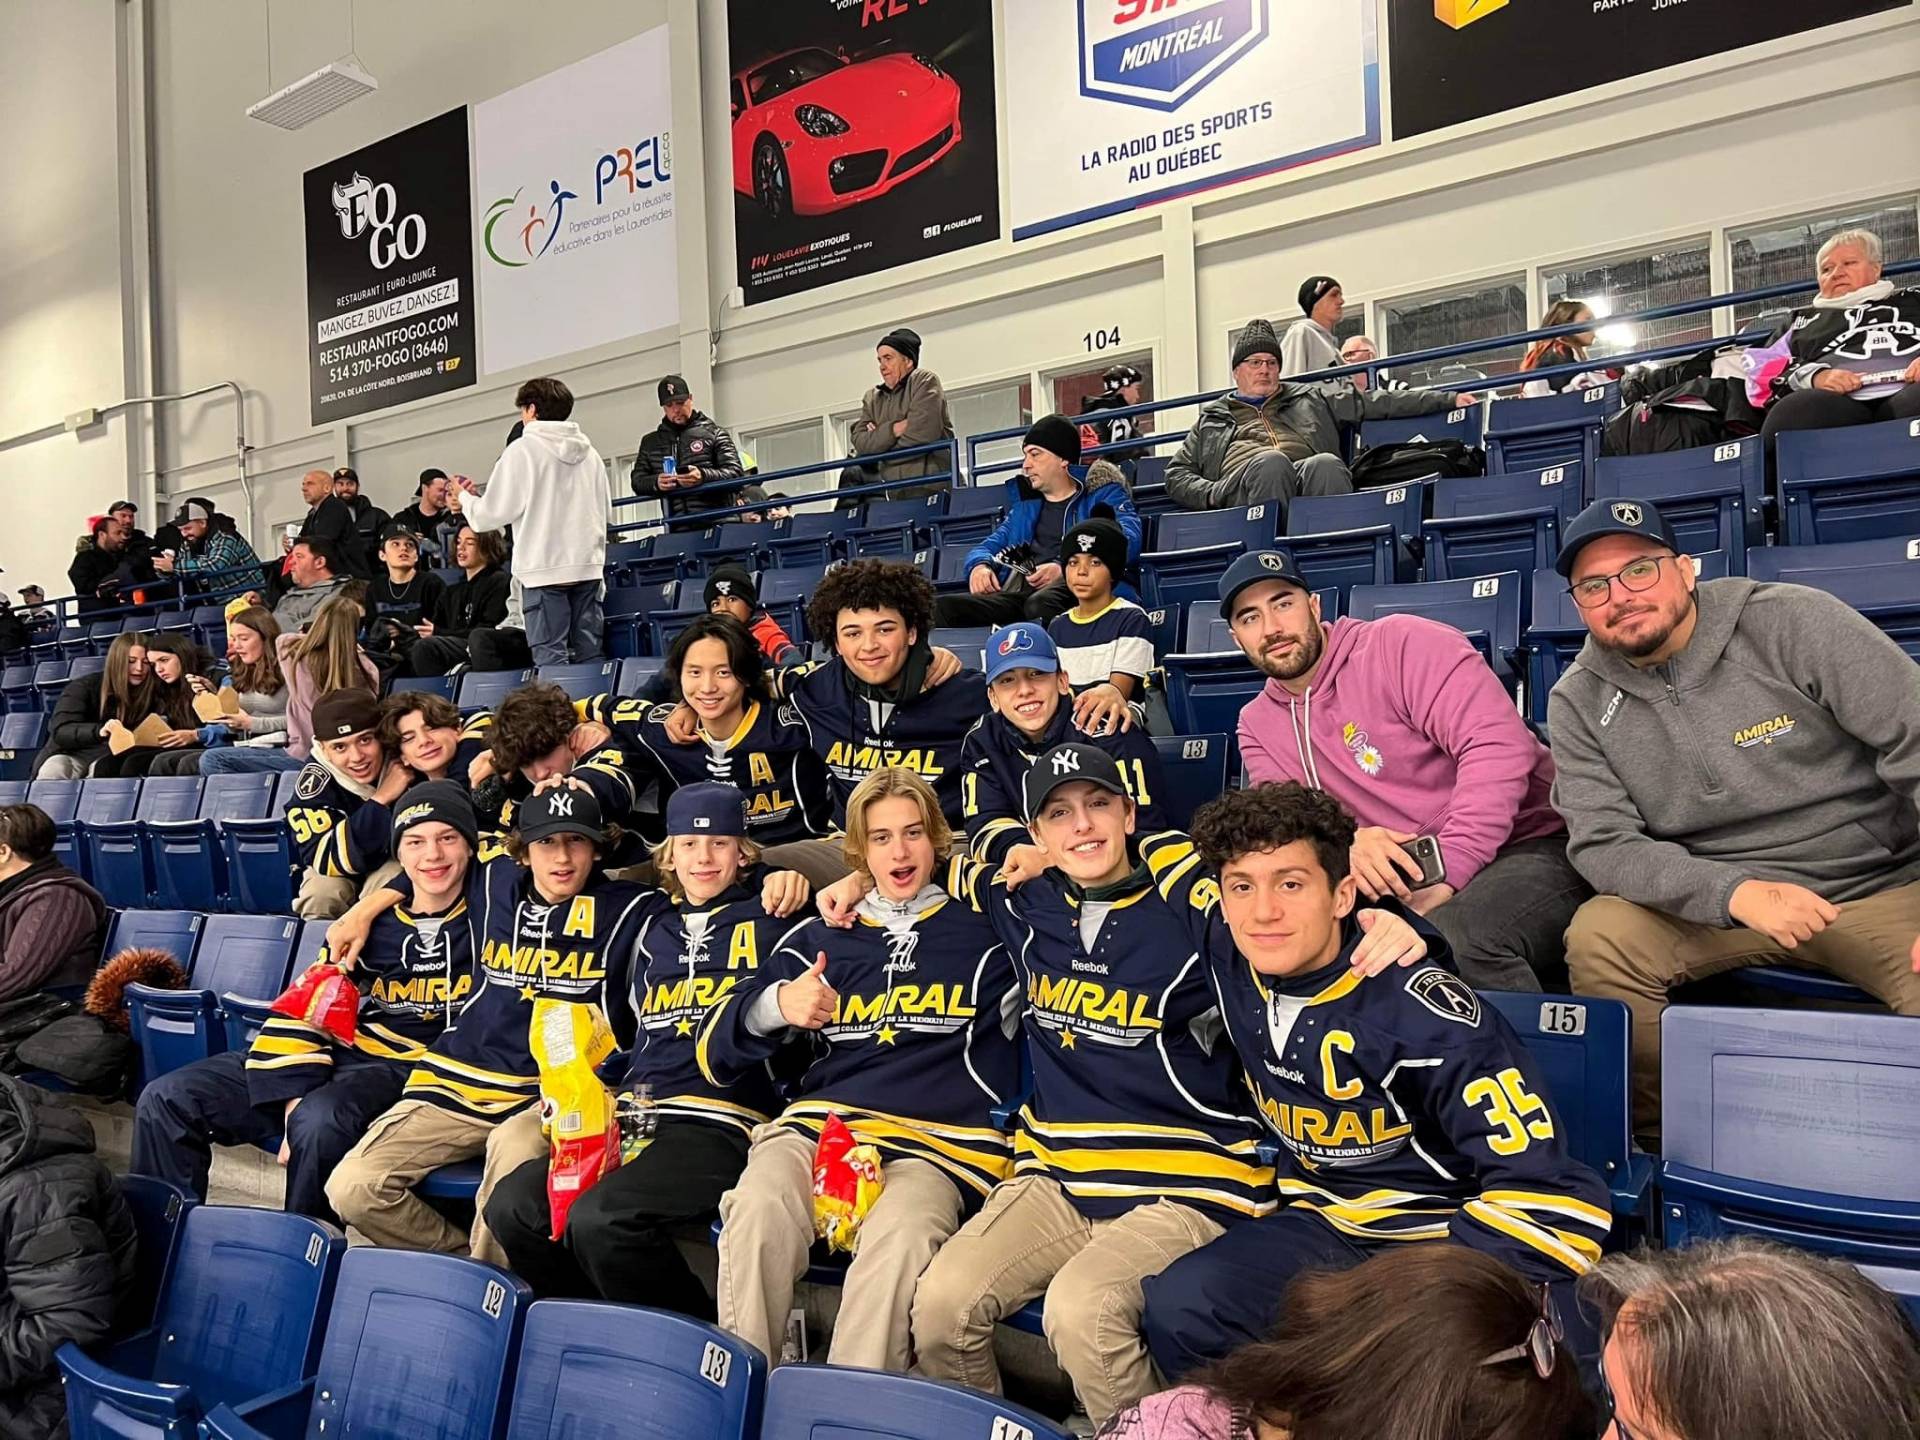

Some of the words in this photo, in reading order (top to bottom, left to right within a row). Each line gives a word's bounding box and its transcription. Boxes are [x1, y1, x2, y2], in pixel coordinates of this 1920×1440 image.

[1119, 16, 1224, 73] MONTRÉAL
[1082, 151, 1101, 171] LA
[1107, 134, 1157, 163] RADIO
[1163, 123, 1195, 148] DES
[1200, 101, 1273, 137] SPORTS
[595, 136, 671, 205] PREL
[1128, 164, 1150, 184] AU
[1156, 142, 1223, 175] QUÉBEC
[612, 207, 631, 222] pour
[632, 201, 641, 212] la
[592, 229, 613, 242] dans
[614, 223, 625, 236] les
[773, 244, 810, 262] LOUELAVIE
[810, 232, 851, 252] EXOTIQUES
[336, 284, 381, 308] RESTAURANT
[386, 265, 437, 292] EURO-LOUNGE
[320, 312, 366, 338] MANGEZ,
[368, 300, 405, 324] BUVEZ,
[319, 312, 459, 367] RESTAURANTFOGO.COM
[1083, 325, 1121, 353] 104
[329, 366, 350, 383] 514
[352, 348, 410, 377] 370-FOGO
[412, 335, 449, 363] (3646)
[347, 386, 355, 397] DE
[355, 384, 363, 394] LA
[397, 366, 433, 383] BOISBRIAND
[1719, 445, 1735, 460] 15
[1544, 468, 1561, 484] 14
[1249, 506, 1262, 520] 12
[1476, 581, 1495, 597] 14
[1600, 689, 1624, 727] CCM
[1733, 714, 1796, 746] AMIRAL
[824, 741, 945, 776] AMIRAL
[1050, 748, 1081, 776] NY
[1186, 741, 1204, 757] 13
[748, 752, 776, 787] A
[548, 792, 574, 816] NY
[563, 895, 595, 938] A
[480, 938, 606, 979] AMIRAL
[727, 919, 759, 969] A
[1071, 959, 1109, 976] Reebok
[371, 974, 472, 1003] AMIRA
[640, 976, 736, 1015] AMIRA
[1027, 971, 1163, 1029] AMIRAL
[1438, 983, 1474, 1013] A
[886, 1015, 897, 1023] DE
[897, 1015, 908, 1023] LA
[1077, 1019, 1088, 1028] LA
[1089, 1022, 1125, 1037] MENNAIS
[1549, 1006, 1577, 1034] 15
[1319, 1029, 1365, 1101] C
[1255, 1080, 1413, 1147] MIRAL
[1462, 1067, 1556, 1157] 35
[1311, 1146, 1324, 1156] LA
[1325, 1146, 1372, 1157] MENNAIS
[308, 1237, 320, 1265] 11
[486, 1283, 503, 1317] 12
[705, 1345, 727, 1383] 13
